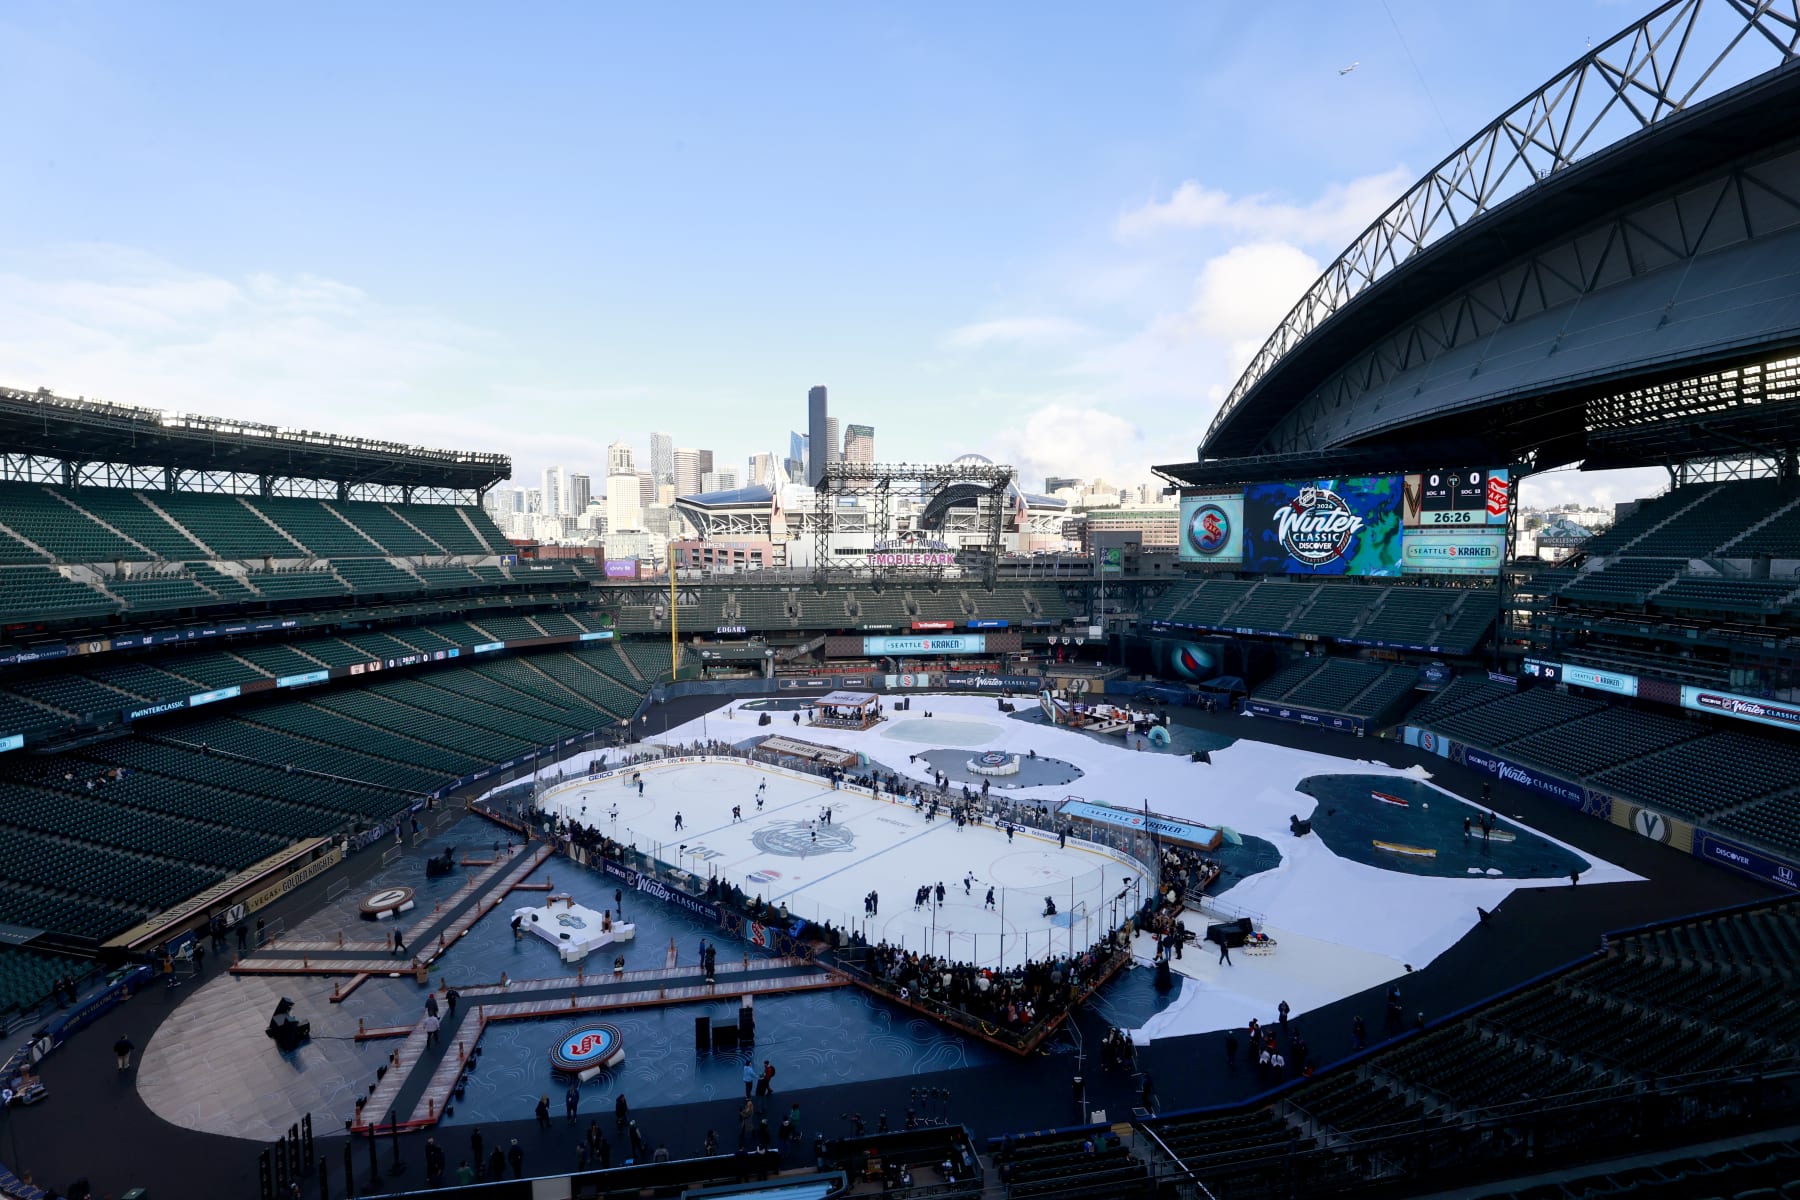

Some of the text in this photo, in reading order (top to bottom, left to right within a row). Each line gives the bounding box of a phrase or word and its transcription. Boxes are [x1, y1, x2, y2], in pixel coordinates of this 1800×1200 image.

[1429, 474, 1440, 487] 0
[1469, 472, 1480, 485] 0
[1434, 512, 1471, 523] 26:26
[1273, 506, 1365, 546] Winter
[1292, 532, 1341, 542] CLASSIC
[1298, 542, 1333, 550] DISCOVER
[1458, 547, 1491, 556] KRAKEN
[866, 553, 956, 565] T-MOBILE PARK
[717, 626, 747, 634] EDGARS
[891, 641, 922, 649] SEATTLE
[931, 639, 960, 649] KRAKEN
[423, 654, 429, 662] 0
[974, 677, 1004, 688] Winter
[131, 700, 185, 719] #WINTERCLASSIC
[1731, 699, 1766, 715] Winter
[1766, 709, 1799, 721] CLASSIC
[667, 756, 695, 764] DISCOVER
[588, 771, 614, 782] GEICO
[1497, 761, 1533, 785] Winter
[1533, 778, 1568, 798] CLASSIC
[1090, 809, 1130, 822] SEATTLE
[1141, 819, 1182, 834] KRAKEN
[1715, 847, 1750, 866] DISCOVER
[254, 855, 335, 907] VEGAS GOLDEN KNIGHTS
[1772, 875, 1798, 888] HONDA
[635, 872, 671, 902] Winter
[671, 892, 709, 914] CLASSIC
